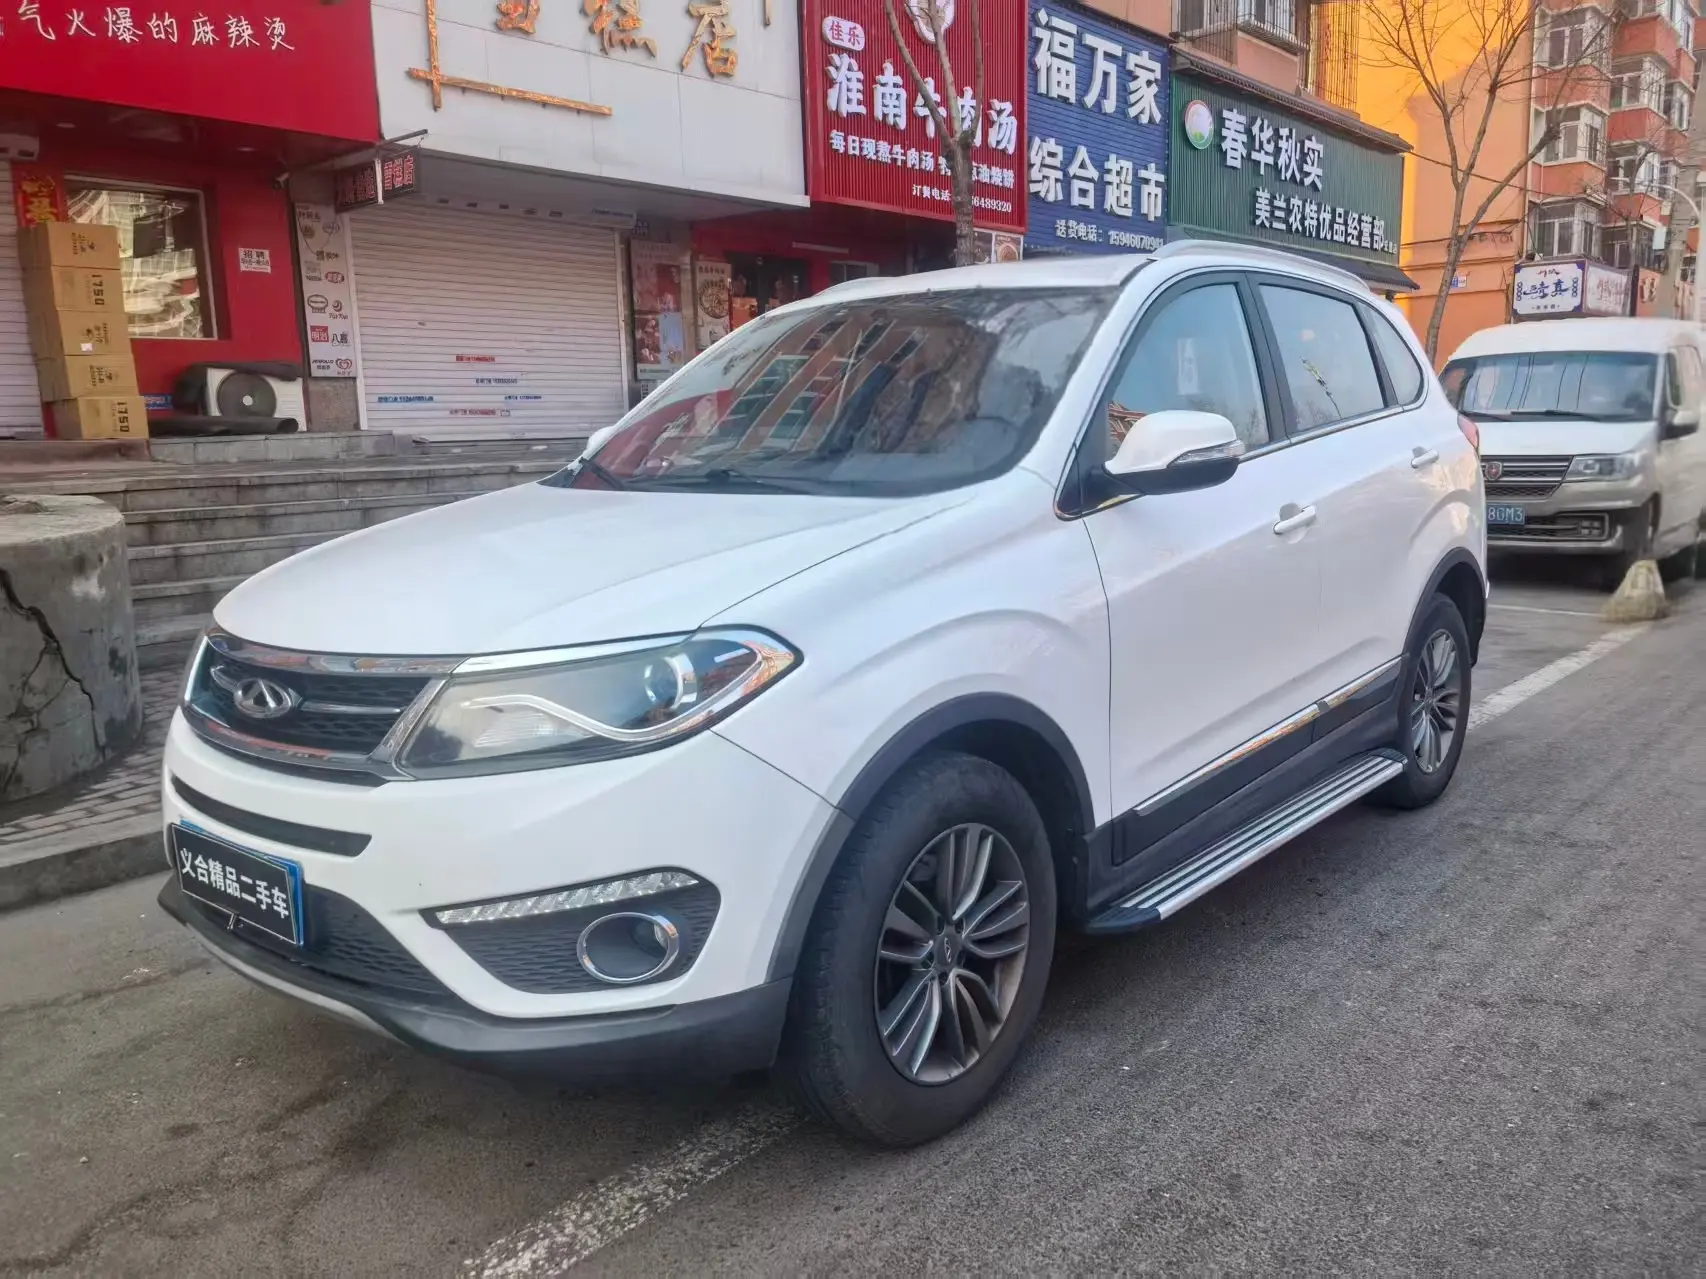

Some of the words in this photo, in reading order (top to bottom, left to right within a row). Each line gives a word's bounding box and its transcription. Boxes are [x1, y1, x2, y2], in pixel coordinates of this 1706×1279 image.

[829, 20, 861, 47] 佳乐
[1033, 8, 1163, 125] 福万家
[825, 53, 1018, 155] 淮南牛肉汤
[829, 129, 935, 172] 每日现熬牛肉汤
[1030, 136, 1166, 222] 综合超市
[1221, 108, 1324, 192] 春华秋实
[1254, 186, 1385, 252] 美兰农特优品经营部
[180, 848, 289, 919] 义合精品二手车
